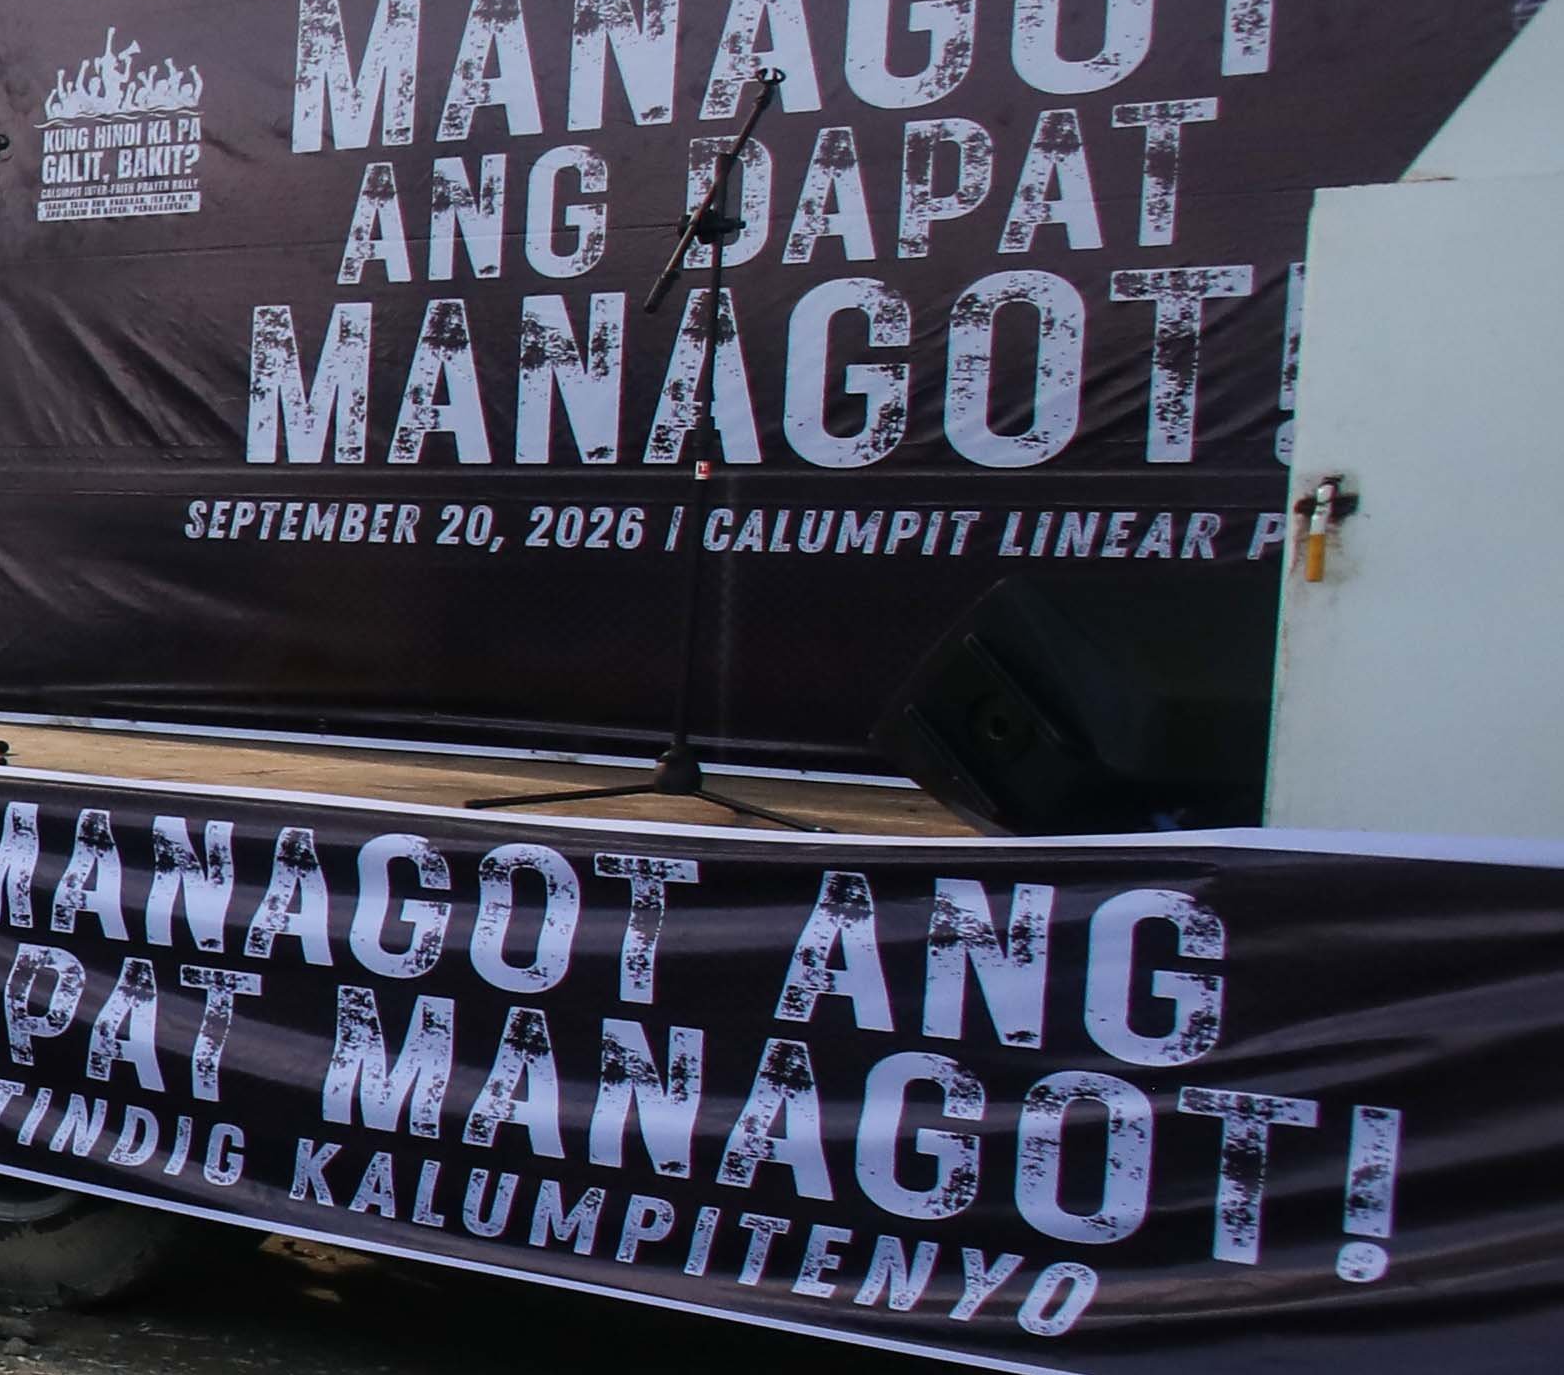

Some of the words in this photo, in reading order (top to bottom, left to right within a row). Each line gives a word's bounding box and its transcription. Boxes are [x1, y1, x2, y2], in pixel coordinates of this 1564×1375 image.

[42, 150, 110, 184] GALIT,
[117, 144, 200, 180] BAKIT?
[43, 127, 90, 154] KUNG
[94, 122, 141, 149] HINDI
[147, 119, 171, 145] KA
[177, 117, 201, 142] PA
[336, 144, 609, 285] ANG
[682, 96, 1219, 270] DAPAT
[184, 500, 421, 546] SEPTEMBER
[437, 503, 506, 553] 20,
[526, 505, 646, 551] 2026
[703, 507, 982, 556] CALUMPIT
[998, 510, 1222, 560] LINEAR
[774, 869, 1226, 1068] ANG
[322, 984, 1403, 1284] MANAGOT!
[289, 1138, 1100, 1337] KALUMPITENYO
